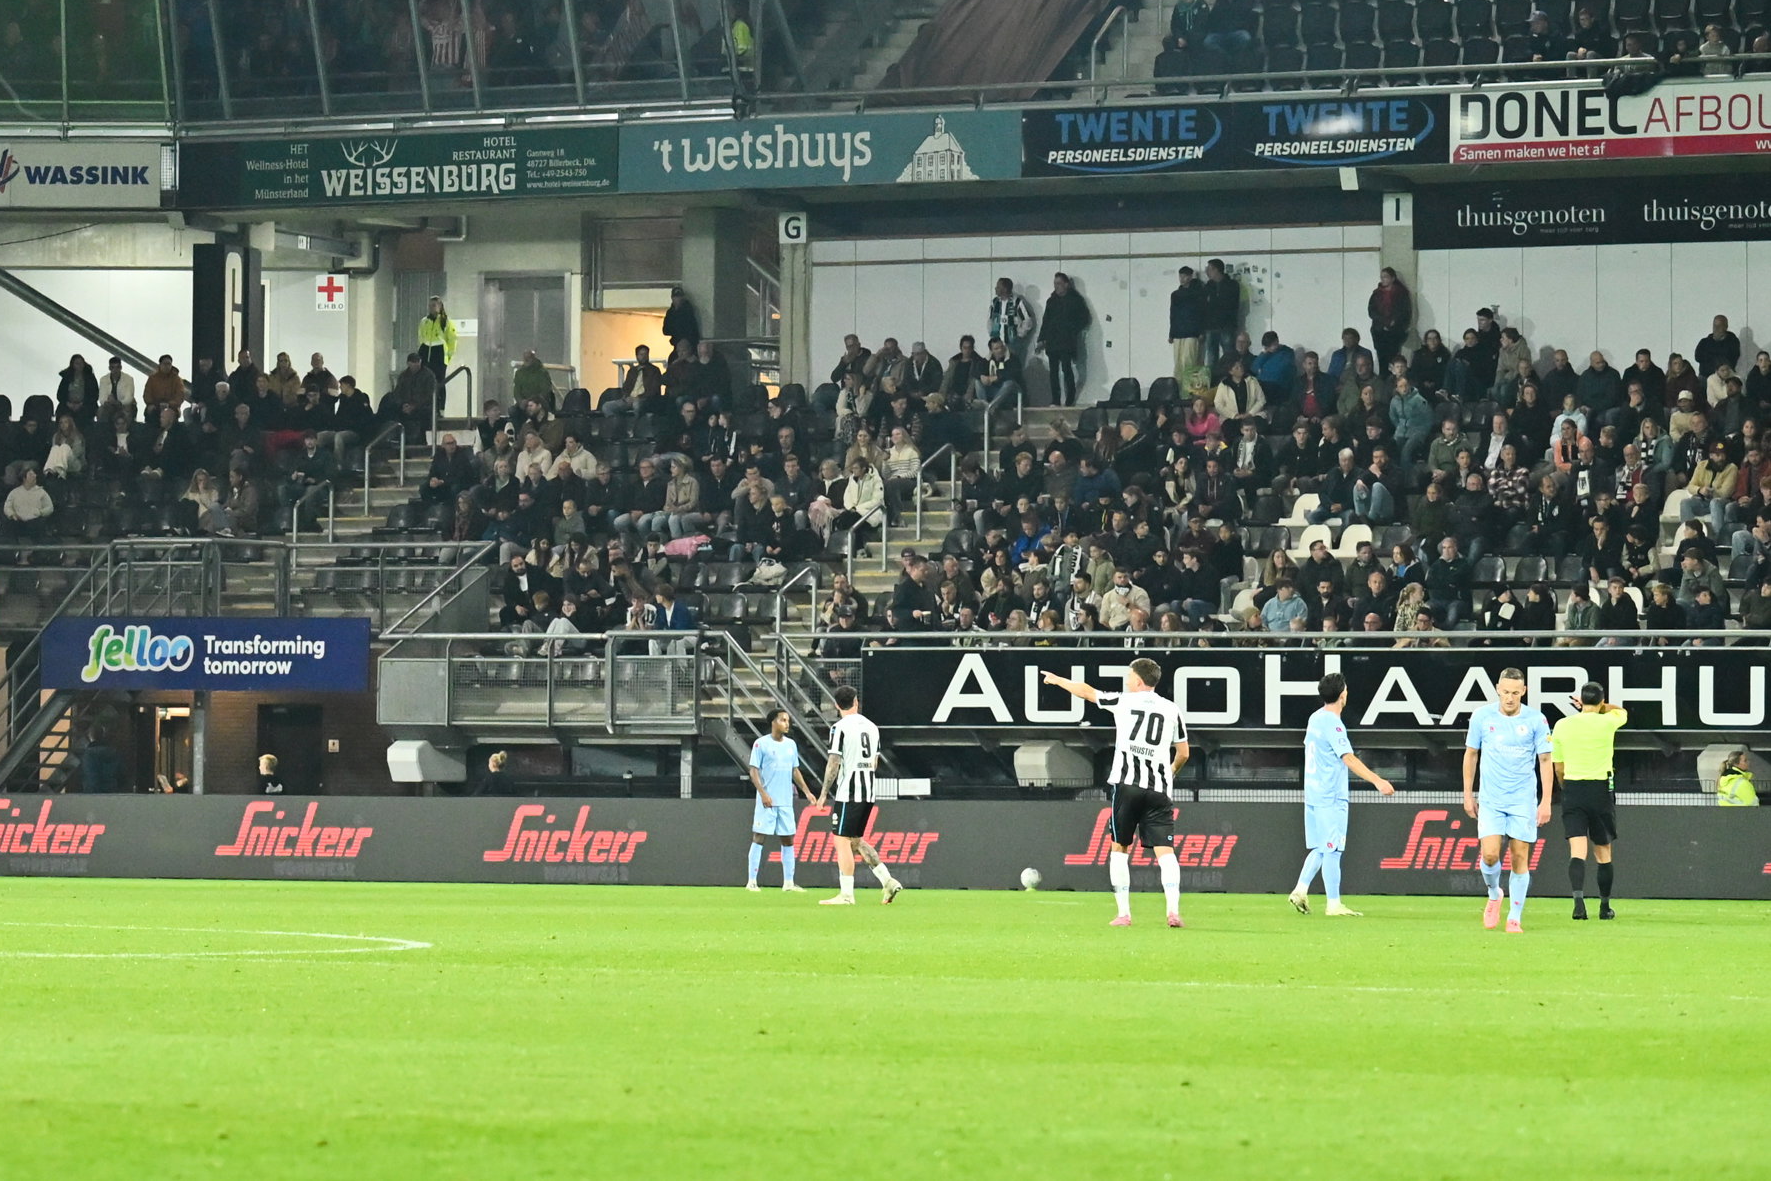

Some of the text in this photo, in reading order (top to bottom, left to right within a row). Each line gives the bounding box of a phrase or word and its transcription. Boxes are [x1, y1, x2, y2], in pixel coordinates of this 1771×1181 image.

[1055, 109, 1197, 145] TWENTE
[1262, 99, 1409, 137] TWENTE
[290, 144, 309, 155] HET
[483, 136, 517, 148] HOTEL
[1254, 137, 1416, 157] PERSONEELSDIENSTEN
[1459, 142, 1606, 160] Samen maken we het af
[246, 159, 309, 171] Wellness-Hotel
[452, 149, 517, 161] RESTAURANT
[1047, 146, 1204, 164] PERSONEELSDIENSTEN
[24, 165, 149, 186] WASSINK
[283, 173, 309, 184] in het
[321, 163, 517, 197] WEISSENBURG
[254, 188, 309, 200] Münsterland
[783, 216, 802, 240] G
[1457, 204, 1605, 236] thuisgenoten
[81, 624, 325, 683] felloo Transforming
[203, 657, 293, 675] tomorrow
[1129, 709, 1165, 746] 70
[861, 732, 871, 759] 9
[215, 801, 372, 856] Snickers
[483, 805, 647, 862] Snickers
